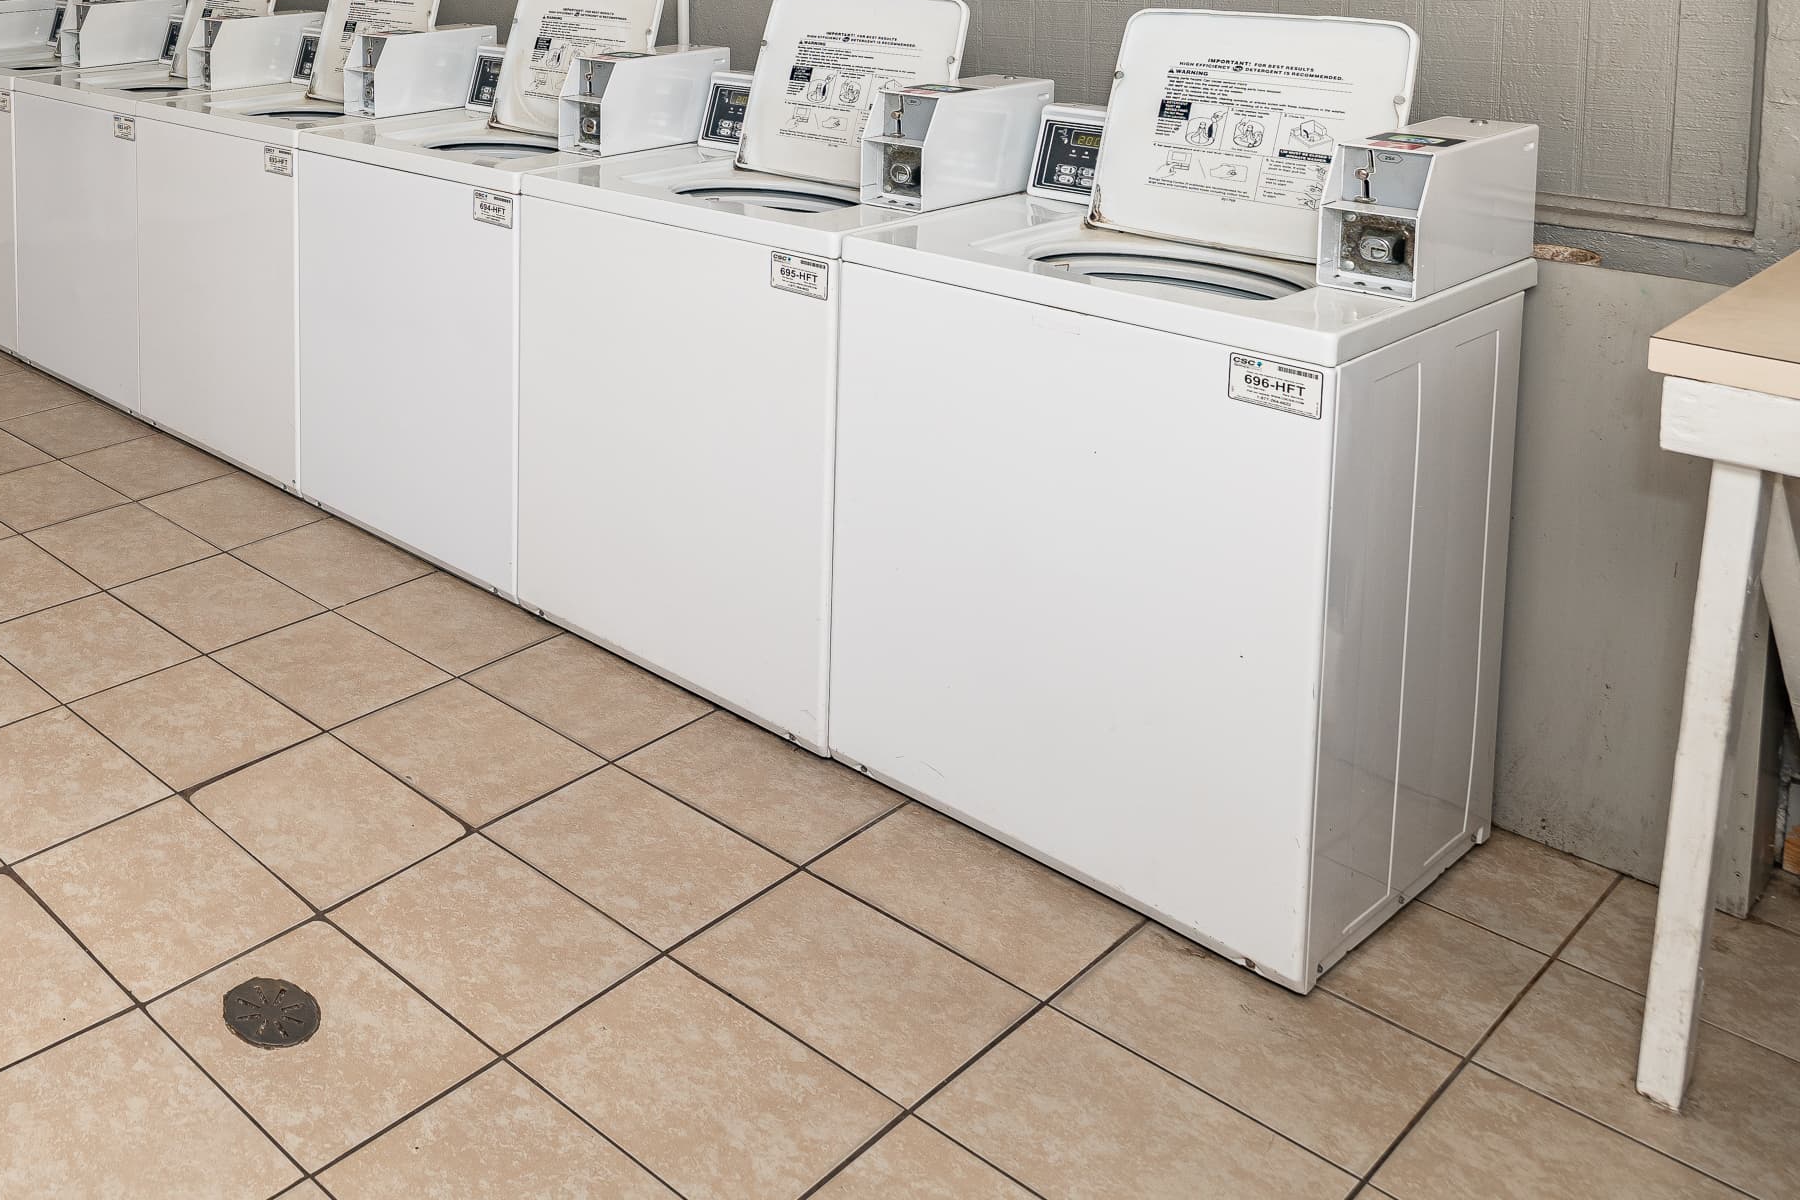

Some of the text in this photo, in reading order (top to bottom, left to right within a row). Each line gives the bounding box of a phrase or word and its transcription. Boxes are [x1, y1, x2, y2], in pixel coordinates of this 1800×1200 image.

[1207, 57, 1252, 67] IMPORTANT!
[1245, 67, 1283, 75] DETERGENT
[1291, 72, 1343, 81] RECOMMENDED.
[480, 202, 506, 215] 694-HFT
[773, 253, 787, 261] CSC
[780, 267, 818, 283] 695-HFT
[1233, 356, 1256, 366] CSC
[1244, 374, 1306, 397] 696-HFT
